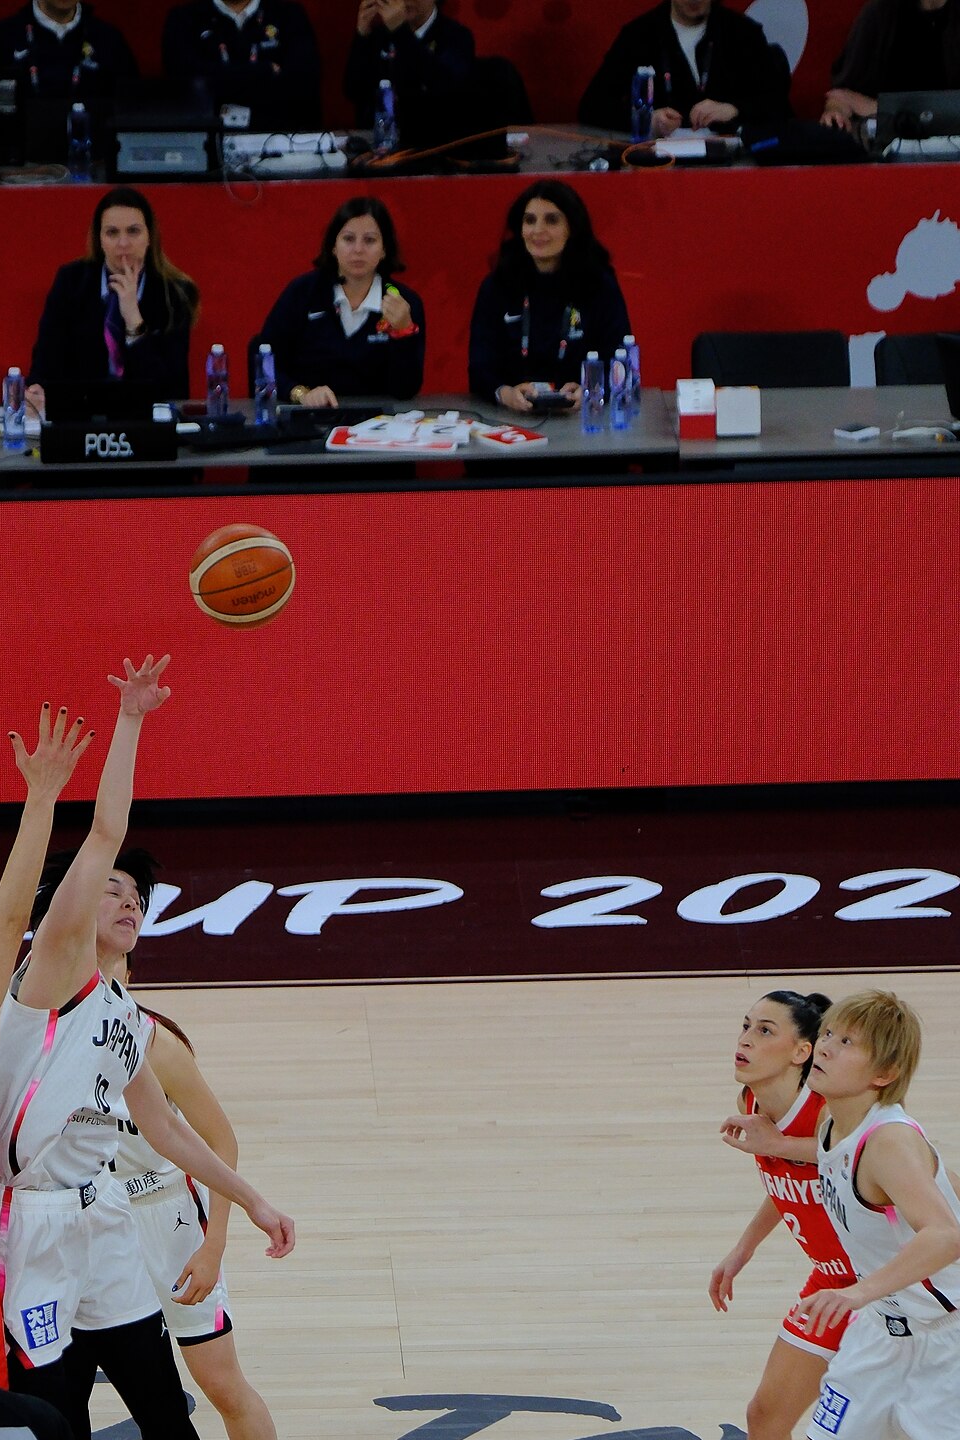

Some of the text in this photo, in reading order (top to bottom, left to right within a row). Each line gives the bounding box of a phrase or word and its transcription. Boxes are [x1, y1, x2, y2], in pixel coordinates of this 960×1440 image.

[231, 585, 277, 607] molten
[531, 867, 960, 929] 202
[92, 1018, 140, 1081] JAPAN
[94, 1073, 111, 1114] 10
[783, 1211, 809, 1245] 2
